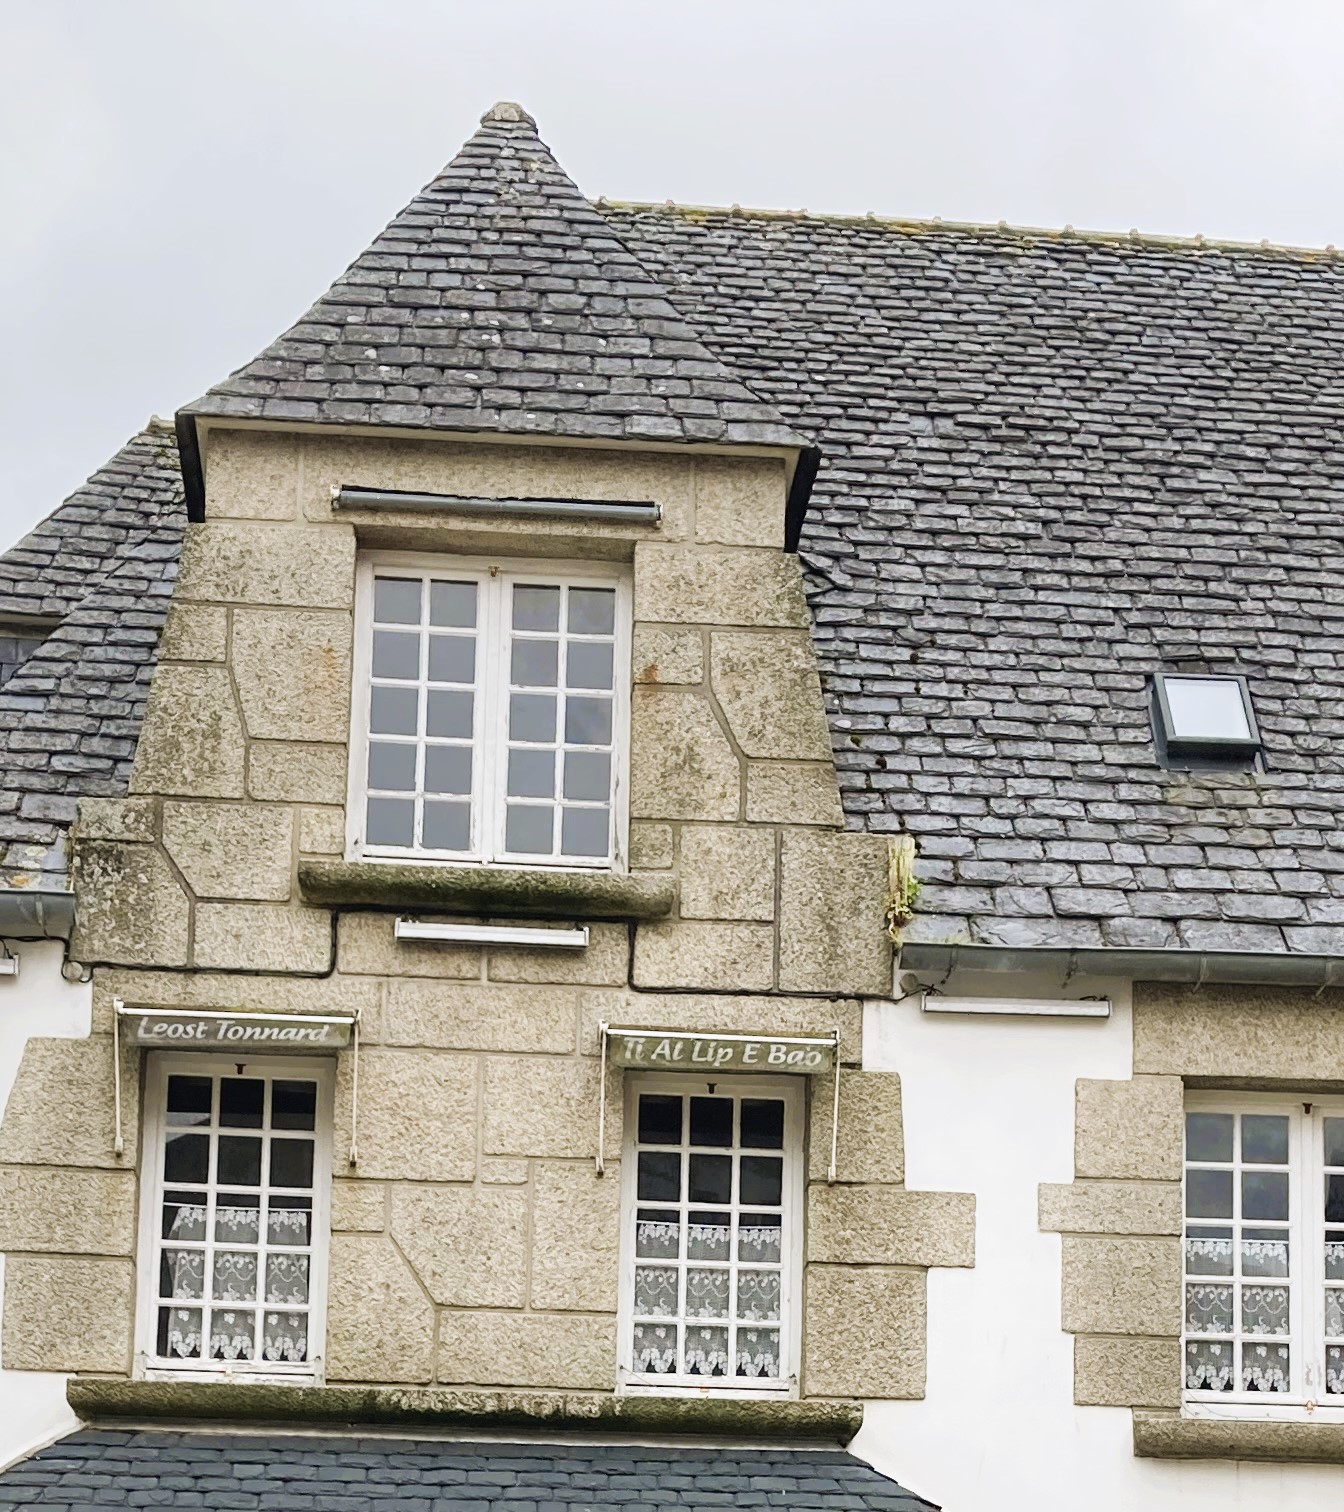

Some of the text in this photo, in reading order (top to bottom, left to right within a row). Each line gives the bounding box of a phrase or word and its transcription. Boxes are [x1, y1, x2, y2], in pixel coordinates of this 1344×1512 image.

[137, 1016, 330, 1042] Leost Tonnard
[623, 1036, 646, 1060] Ti
[651, 1038, 683, 1062] Al
[692, 1040, 733, 1067] Lip
[743, 1042, 761, 1064] E
